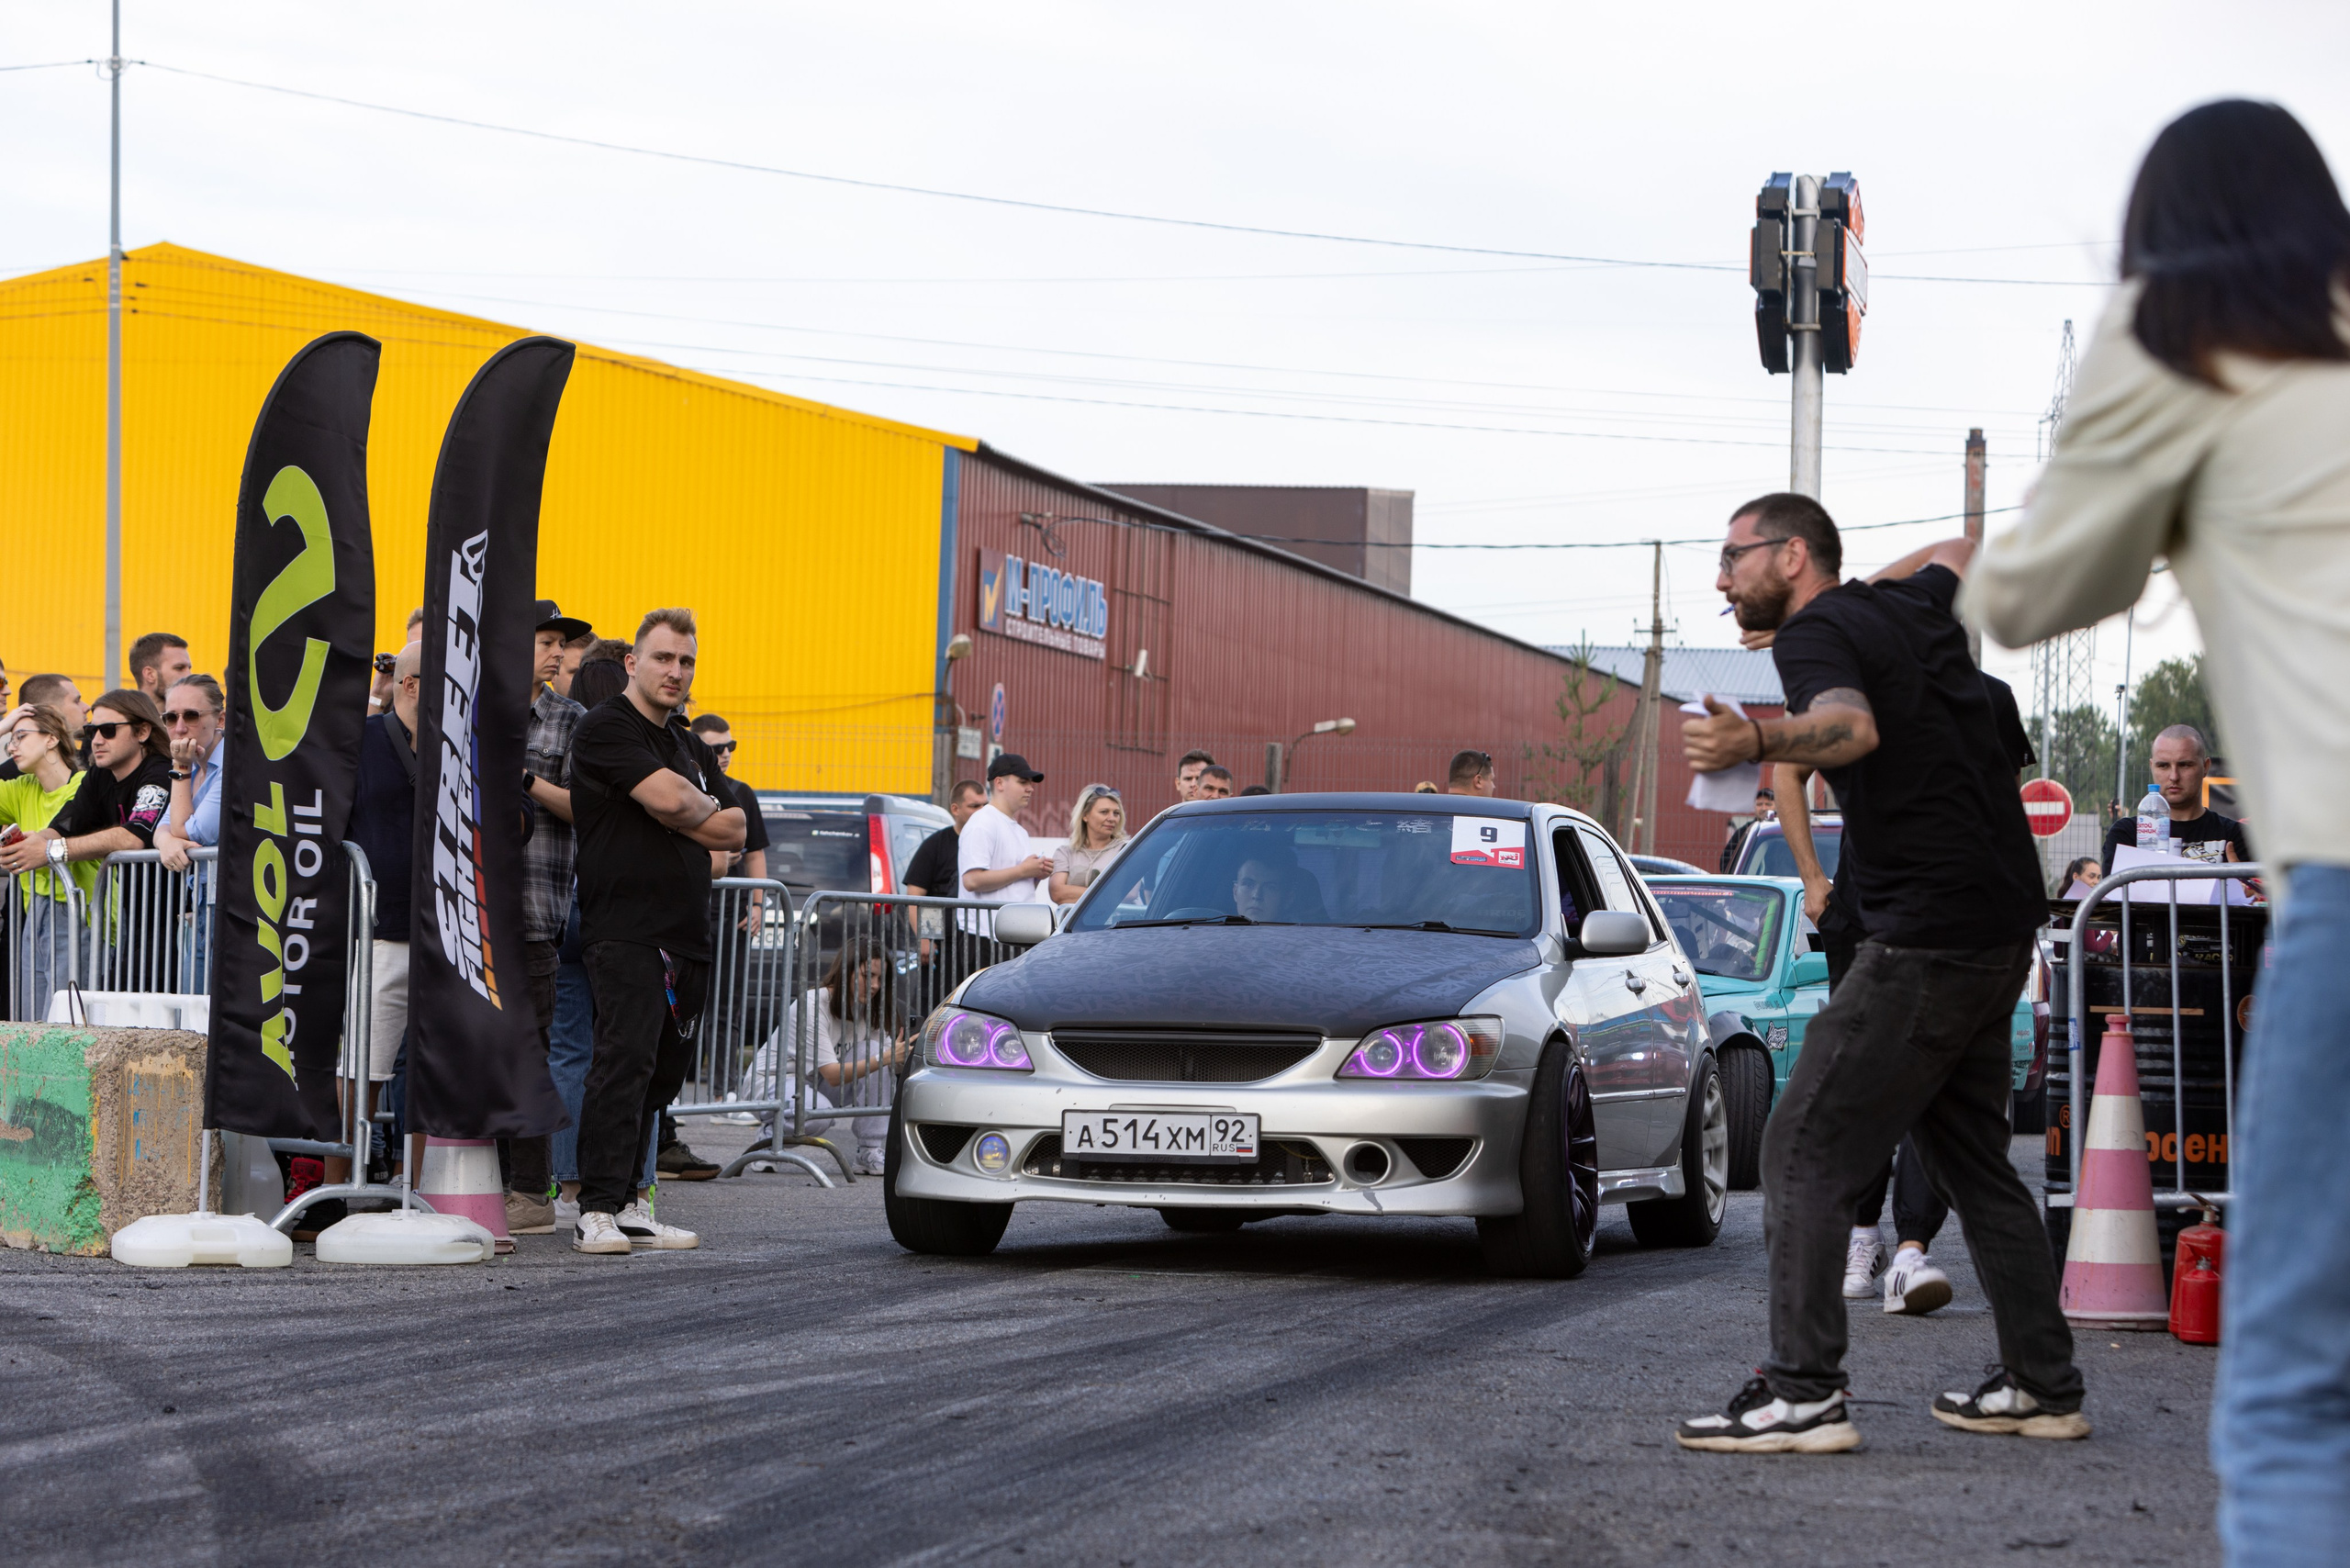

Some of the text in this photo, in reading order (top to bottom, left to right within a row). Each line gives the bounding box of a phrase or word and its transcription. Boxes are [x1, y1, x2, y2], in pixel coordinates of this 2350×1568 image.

[1004, 554, 1108, 640] М-ПРОФИЛЬ
[1005, 618, 1106, 660] СТРОИТЕЛЬНЫЕ ТОВАРЫ
[433, 548, 480, 982] STREET
[292, 788, 323, 878] OIL
[1480, 826, 1498, 843] 9
[252, 780, 297, 1084] AVOL
[1077, 1118, 1246, 1150] А514ХМ 92
[1212, 1143, 1236, 1152] RUS
